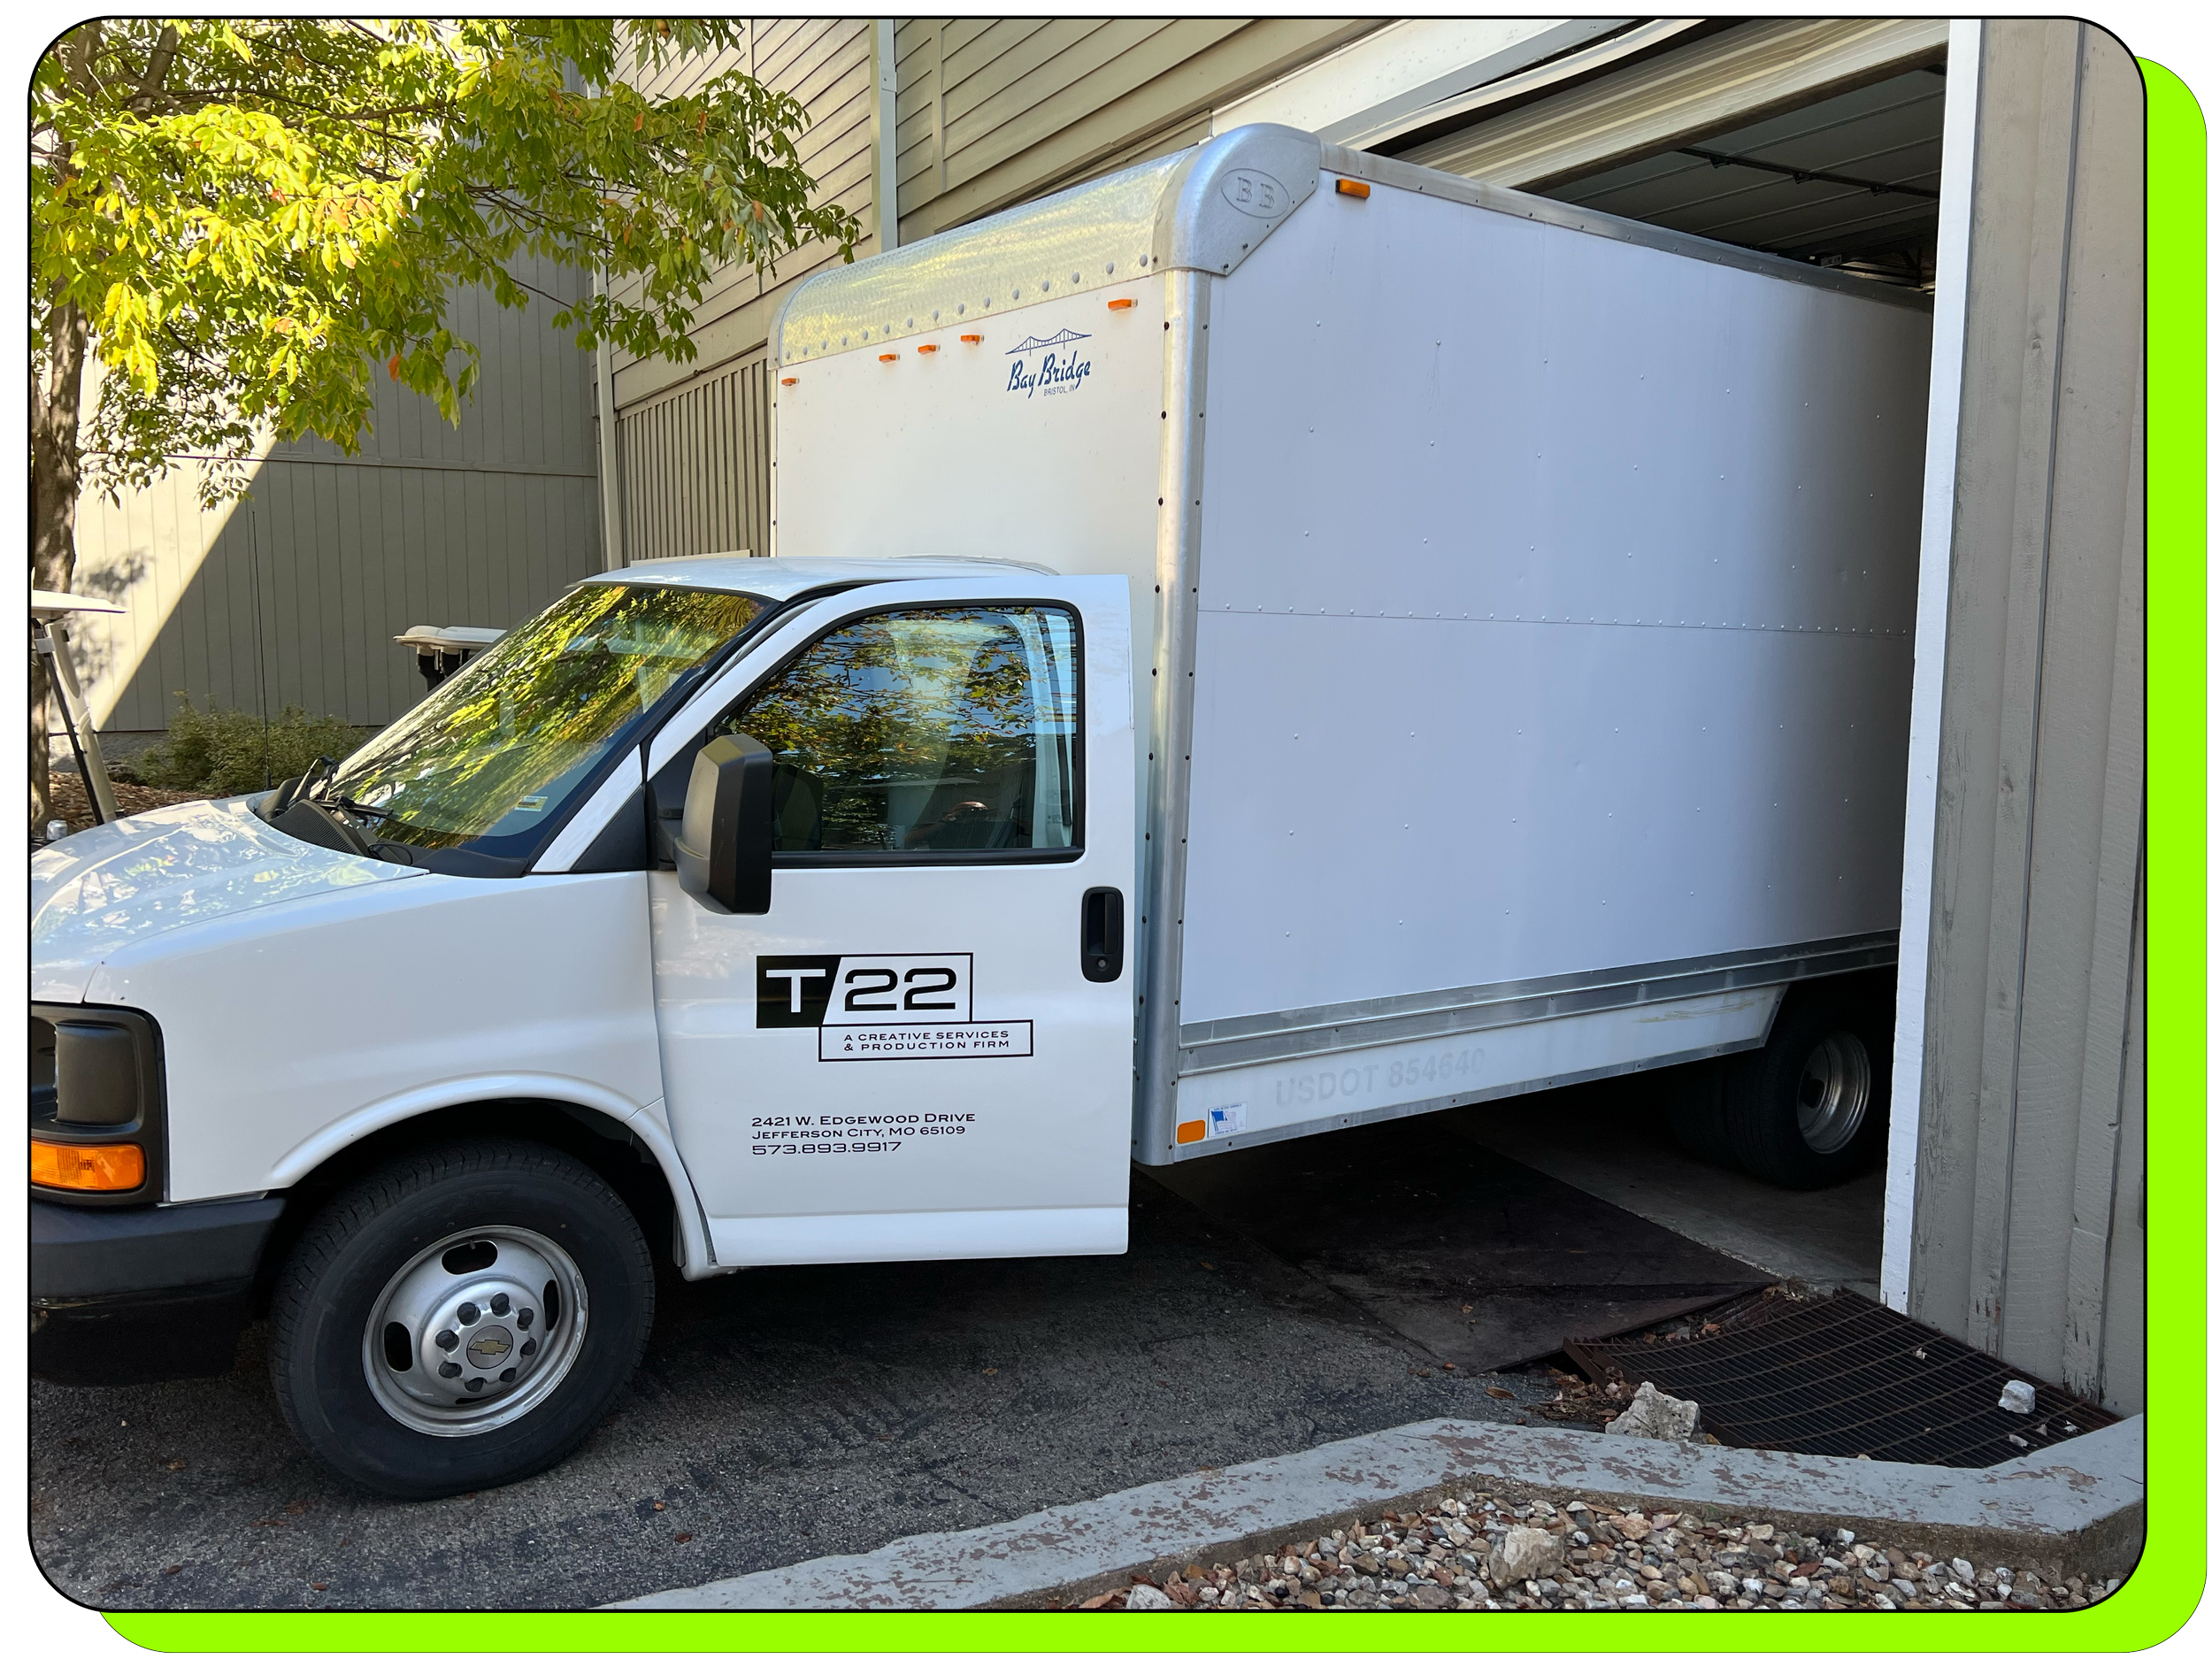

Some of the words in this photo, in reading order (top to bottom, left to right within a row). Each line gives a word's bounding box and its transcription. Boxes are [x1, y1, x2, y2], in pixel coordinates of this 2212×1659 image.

[1007, 359, 1037, 399] Bay
[1038, 349, 1091, 389] Bridge
[765, 967, 957, 1013] T22
[857, 1033, 931, 1041] CREATIVE
[936, 1030, 1009, 1040] SERVICES
[861, 1041, 966, 1051] PRODUCTION
[1275, 1064, 1379, 1107] USDOT
[1387, 1047, 1486, 1089] 854640
[751, 1117, 791, 1127] 2421
[795, 1116, 815, 1126] W.
[819, 1114, 919, 1125] EDGEWOOD
[925, 1113, 976, 1123] DRIVE
[751, 1129, 842, 1140] JEFFERSON
[847, 1128, 885, 1139] CITY,
[889, 1126, 916, 1136] MO
[919, 1125, 965, 1135] 65109
[752, 1141, 902, 1156] 573.893.9917
